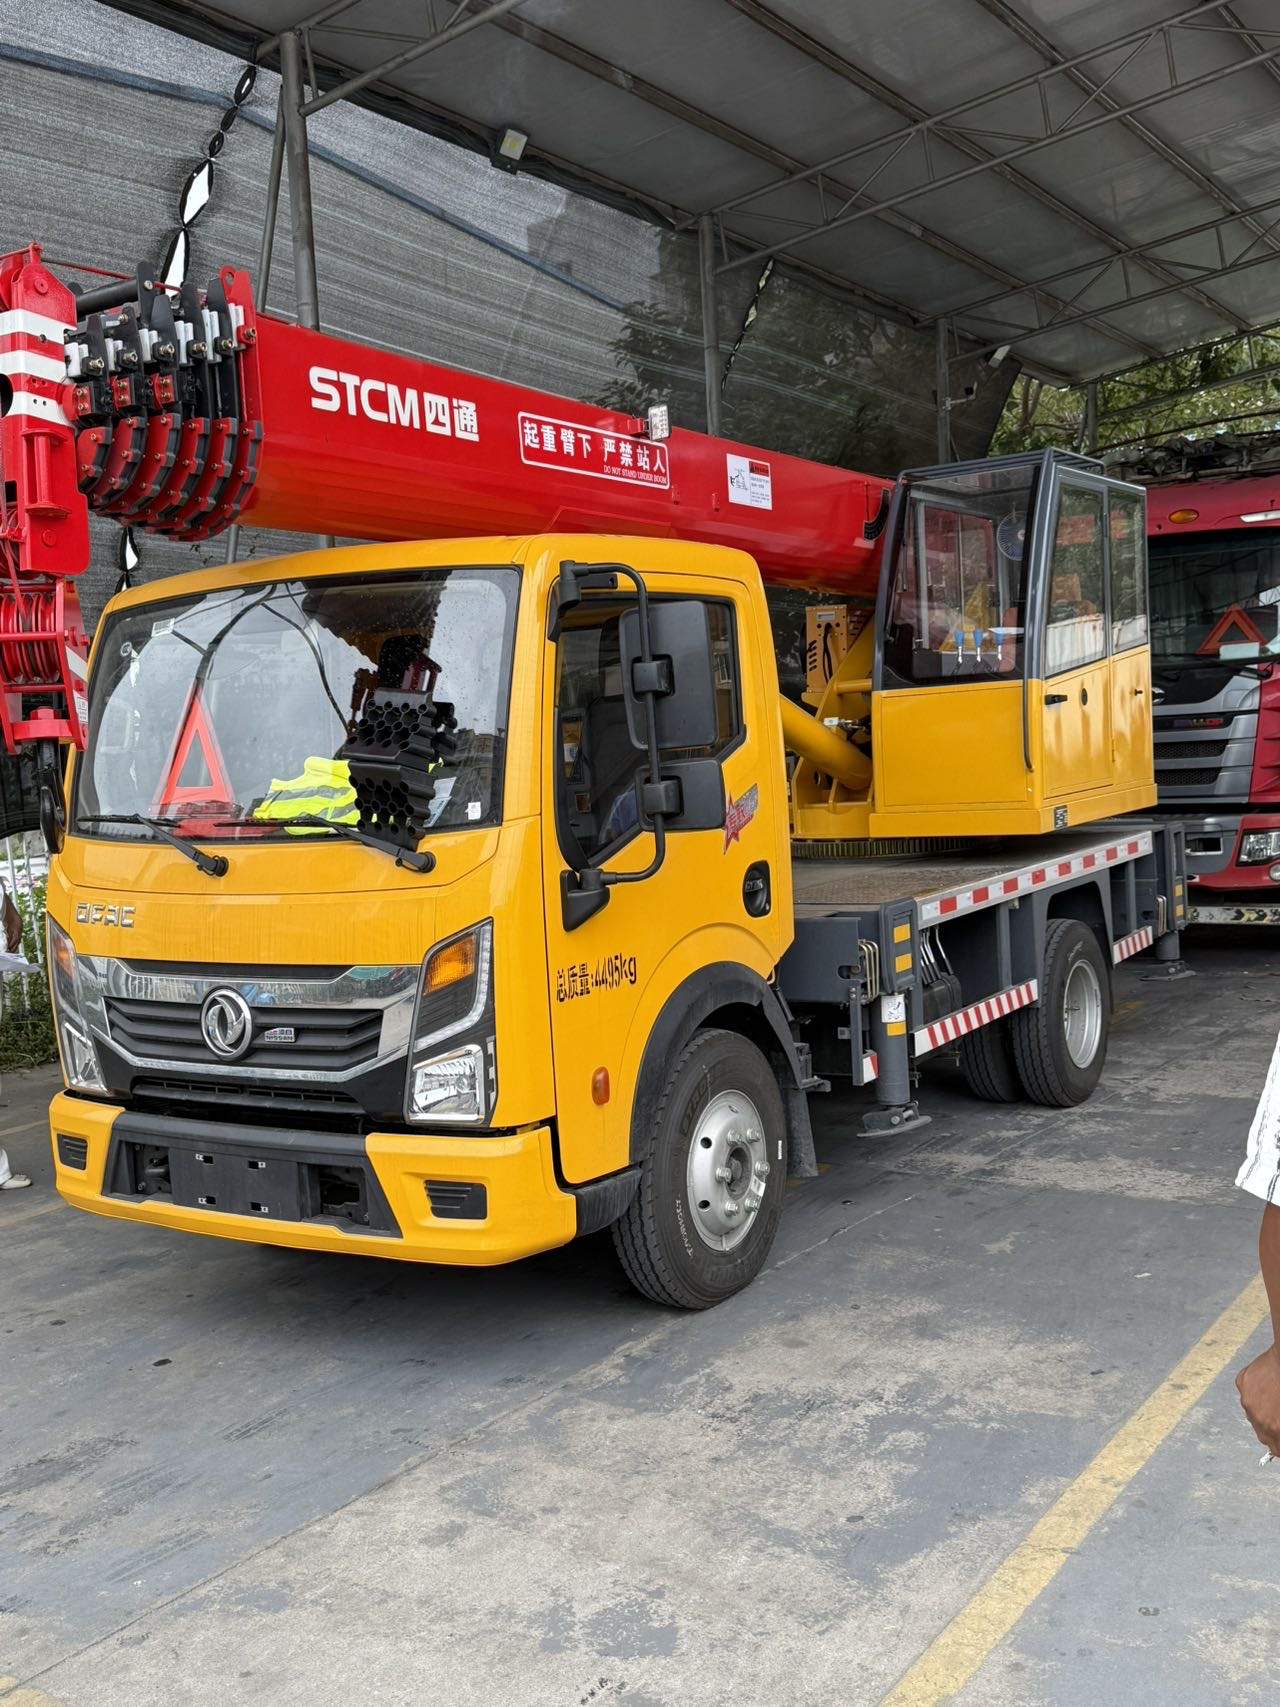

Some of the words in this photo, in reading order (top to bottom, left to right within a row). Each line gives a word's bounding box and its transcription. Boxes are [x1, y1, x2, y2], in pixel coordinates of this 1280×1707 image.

[523, 420, 592, 459] 起重臂下
[602, 437, 666, 474] 严禁站人
[604, 465, 612, 473] DO
[612, 467, 621, 476] NOT
[622, 468, 637, 479] STAND
[638, 471, 653, 482] UNDER
[654, 474, 667, 484] BOOM
